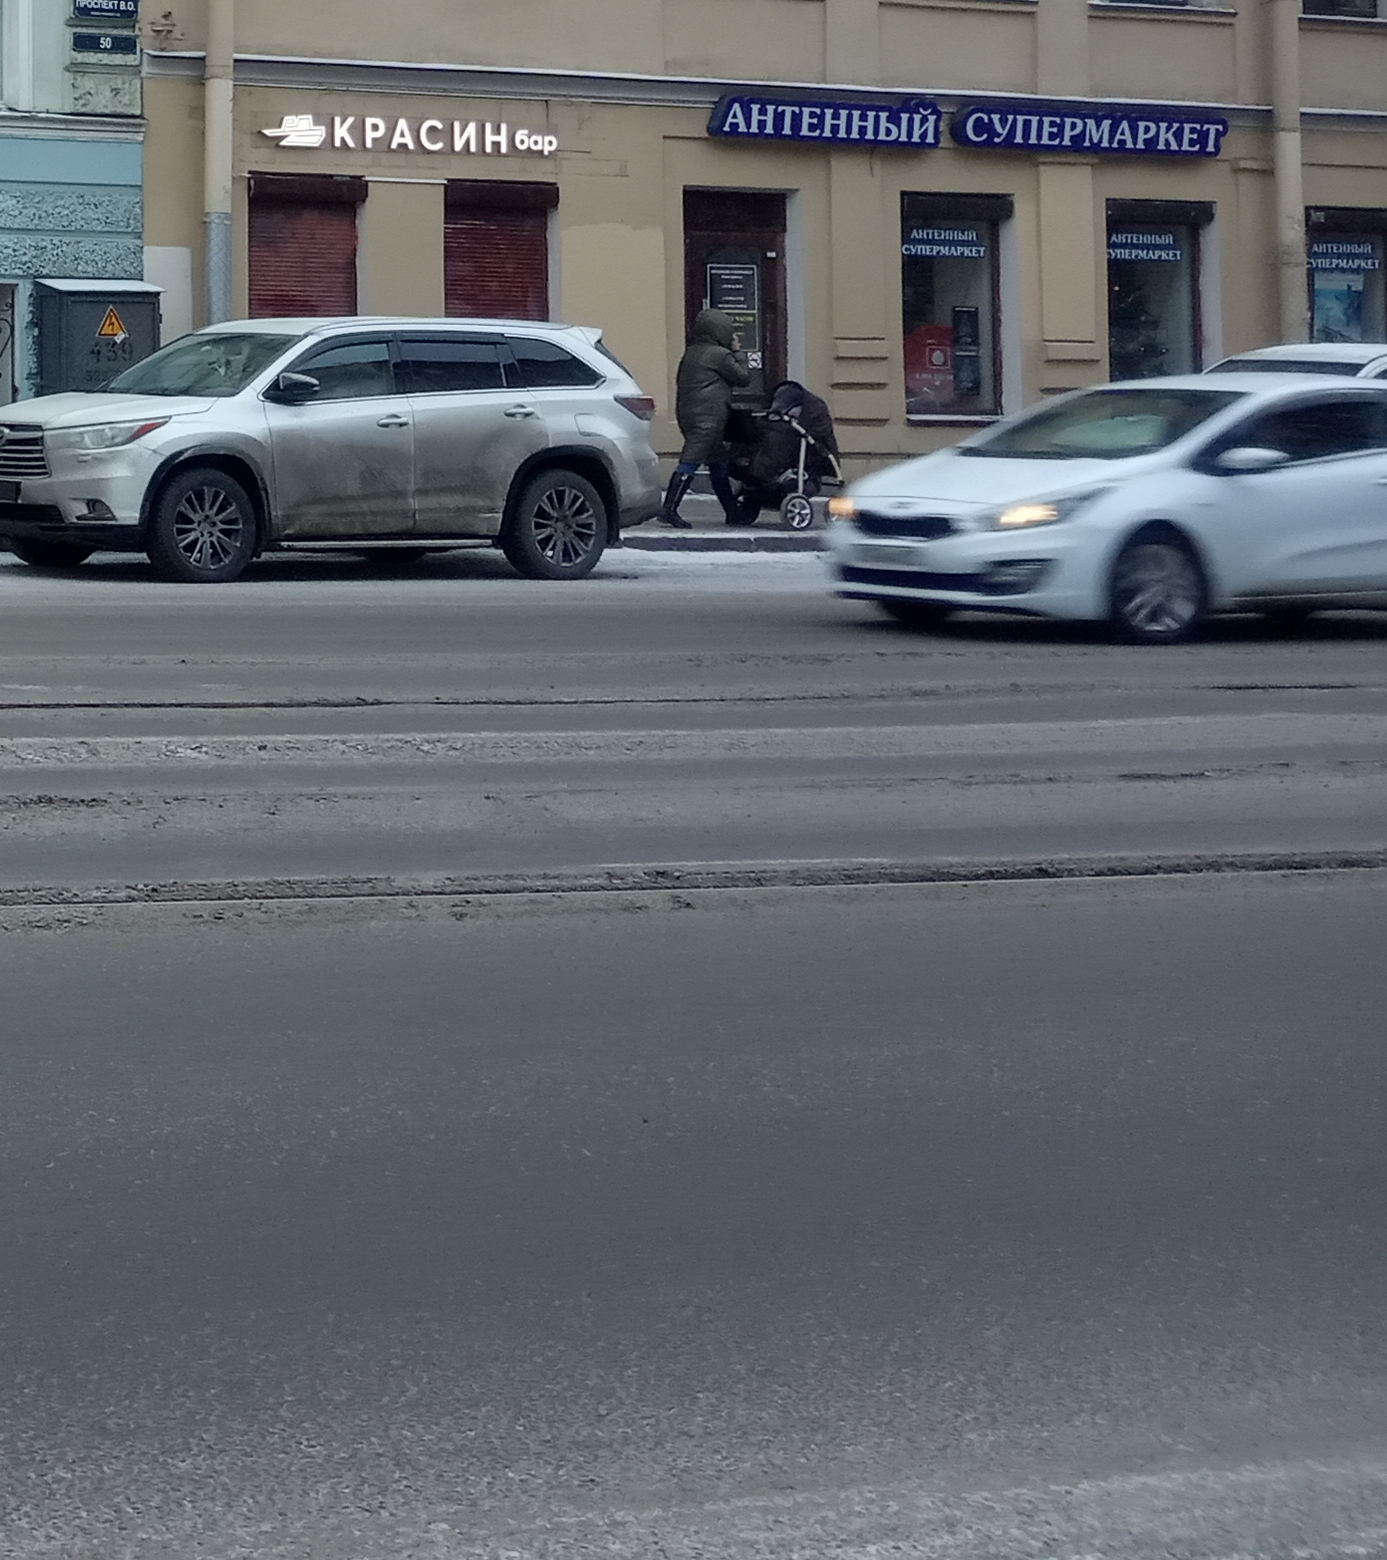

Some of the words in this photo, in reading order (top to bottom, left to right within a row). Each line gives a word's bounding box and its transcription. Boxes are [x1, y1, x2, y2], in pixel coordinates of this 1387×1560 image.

[119, 0, 136, 11] В.О.
[99, 36, 112, 49] 50
[723, 102, 938, 144] АНТЕННЫЙ
[965, 112, 1224, 154] СУПЕРМАРКЕТ
[331, 115, 508, 154] КРАСИН
[514, 129, 558, 155] бар
[910, 228, 977, 241] АНТЕННЫЙ
[1109, 232, 1174, 244] АНТЕННЫЙ
[901, 244, 986, 257] СУПЕРМАРКЕТ
[1311, 242, 1372, 254] АНТЕННЫЙ
